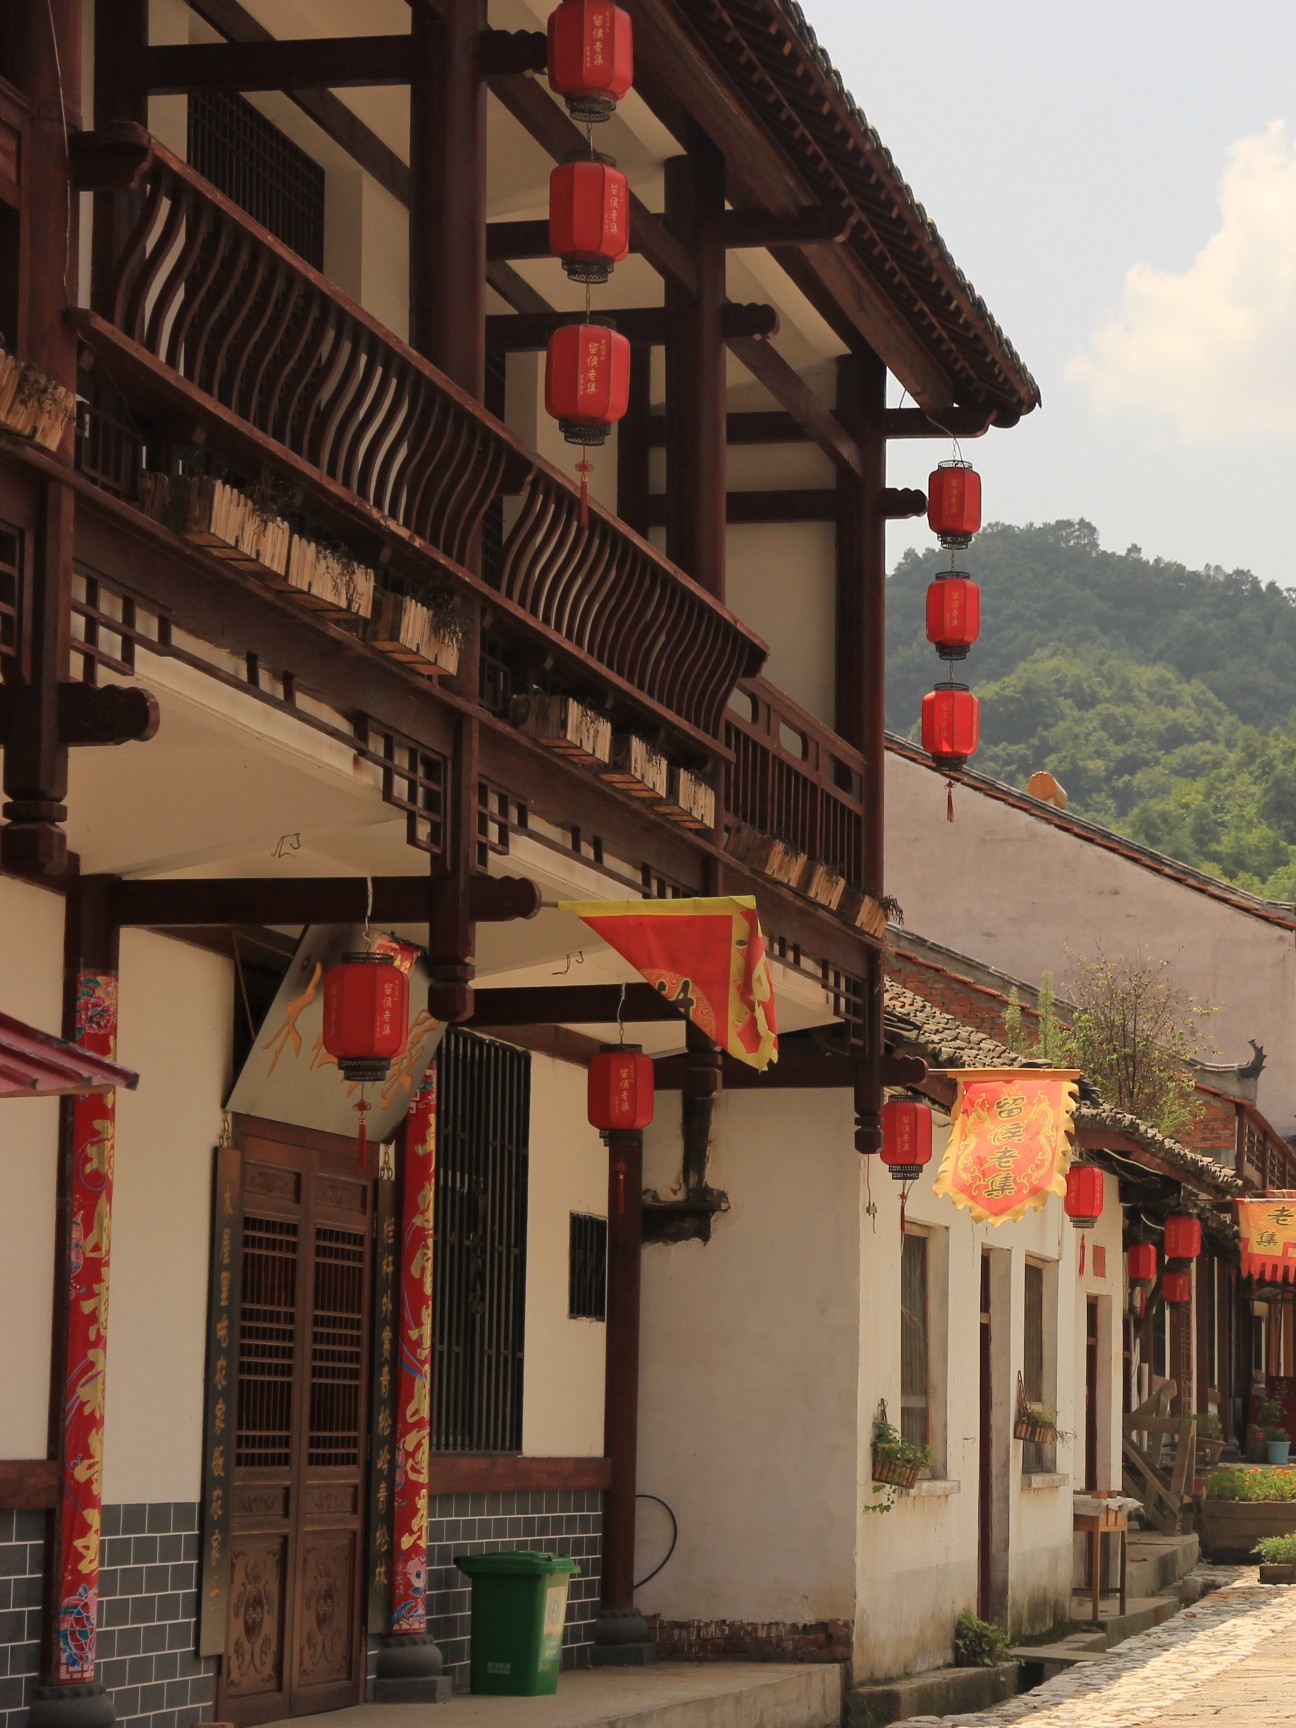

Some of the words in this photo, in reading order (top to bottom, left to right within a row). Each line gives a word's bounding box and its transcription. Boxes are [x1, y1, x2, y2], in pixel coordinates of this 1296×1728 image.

[586, 341, 599, 395] 留侯老集
[382, 982, 394, 1037] 留侯老集
[980, 1096, 1027, 1199] 留侯老集
[1255, 1205, 1295, 1248] 老集
[208, 1183, 234, 1610] 木屋里吃农家饭农家
